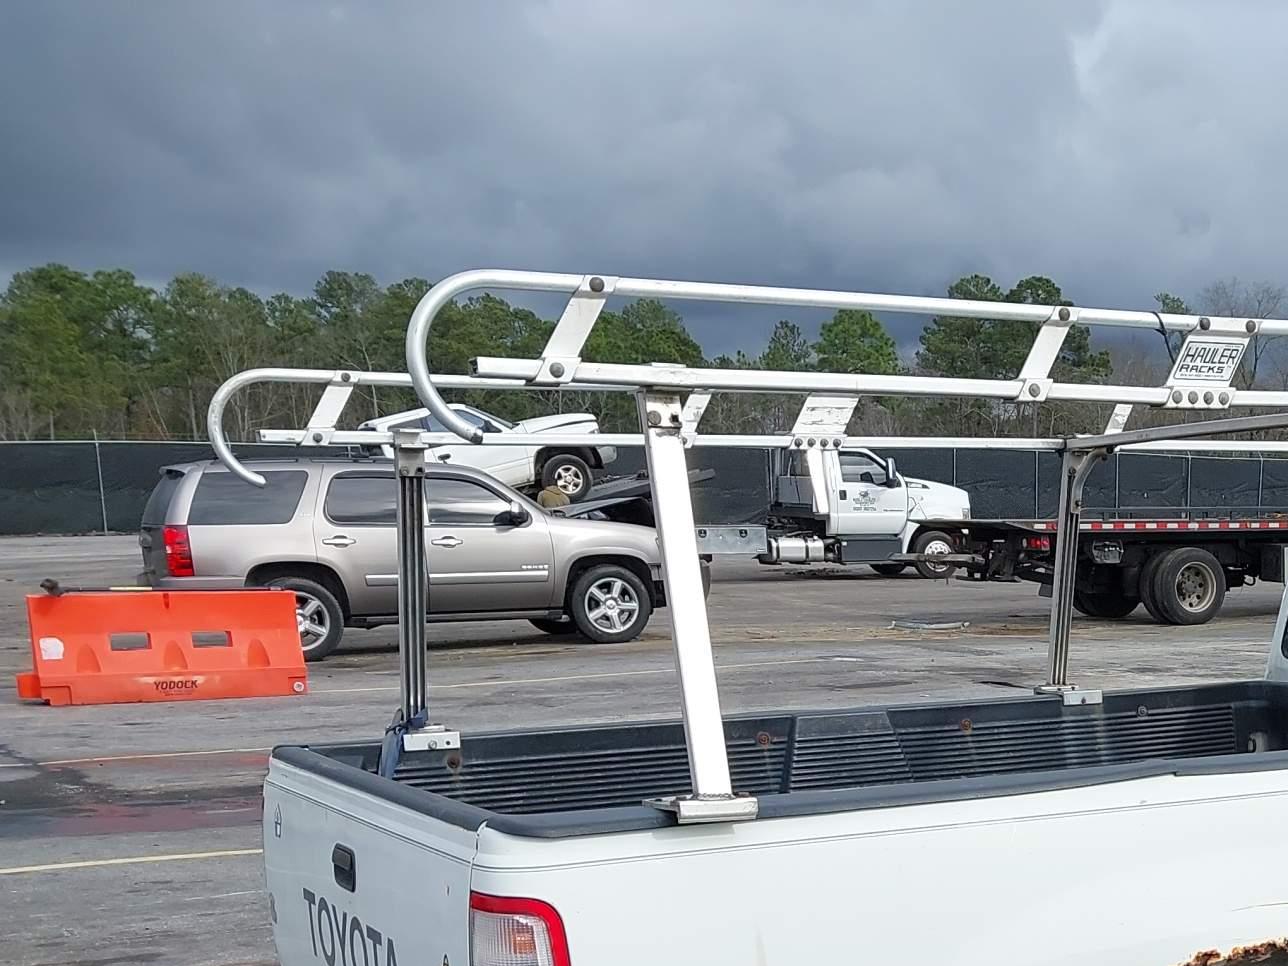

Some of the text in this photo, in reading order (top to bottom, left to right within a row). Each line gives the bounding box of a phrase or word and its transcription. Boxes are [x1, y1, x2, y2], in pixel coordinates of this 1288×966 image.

[1182, 347, 1239, 365] HAULER
[1179, 364, 1225, 374] RACKS
[153, 680, 198, 691] YODOCK
